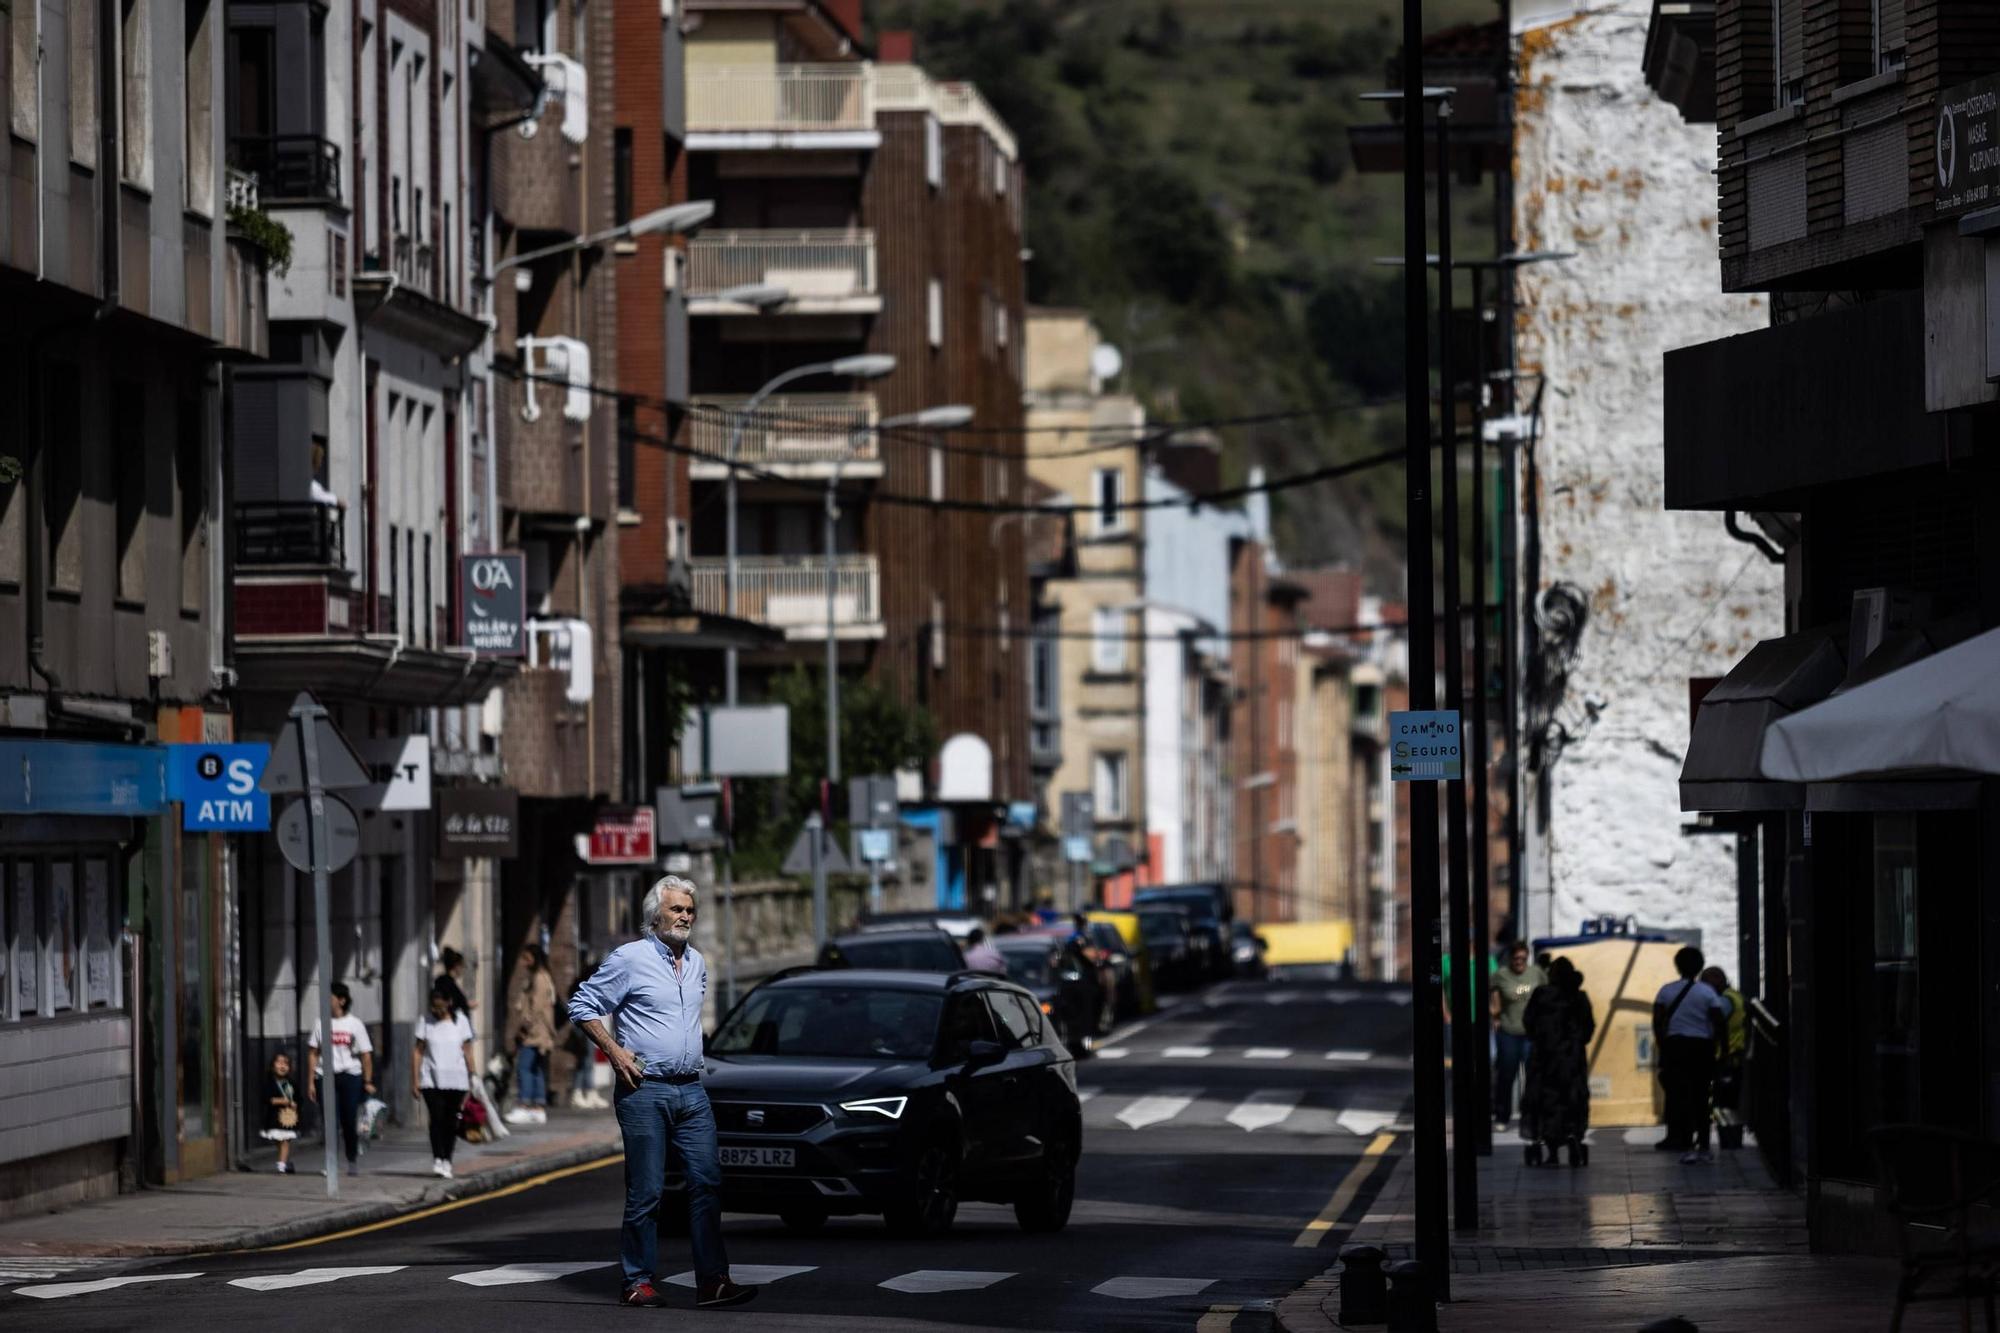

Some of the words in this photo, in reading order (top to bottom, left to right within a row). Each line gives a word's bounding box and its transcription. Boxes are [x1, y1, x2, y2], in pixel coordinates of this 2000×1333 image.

[1395, 741, 1458, 758] SEGURO
[198, 800, 253, 822] ATM
[720, 1148, 759, 1165] 8875
[762, 1150, 792, 1165] LRZ
